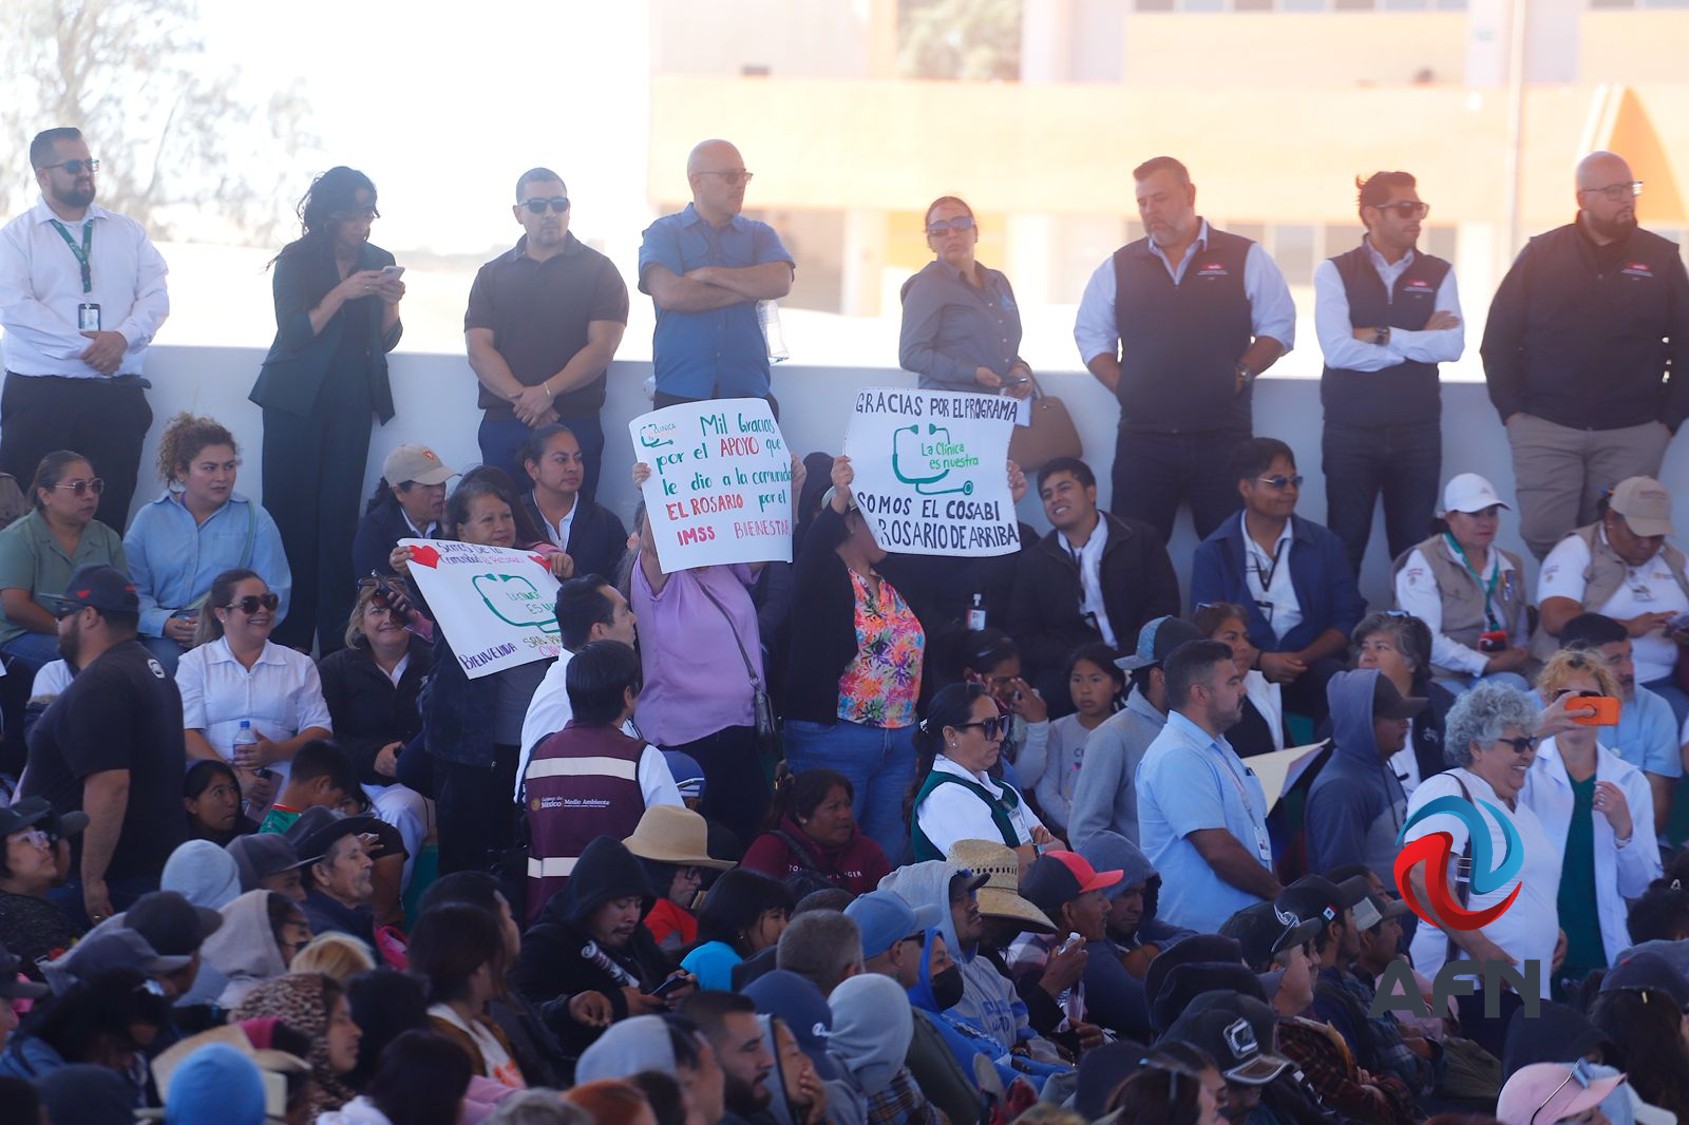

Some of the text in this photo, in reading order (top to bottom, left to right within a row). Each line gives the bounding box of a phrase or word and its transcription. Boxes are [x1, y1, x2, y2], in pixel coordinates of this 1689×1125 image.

[855, 392, 1018, 422] GRACIAS POR EL PROGRAMA
[700, 413, 728, 437] Mil
[738, 413, 775, 433] Gracias
[656, 436, 781, 475] por el APOYO que
[921, 443, 933, 456] La
[930, 453, 979, 470] es nuestra
[662, 479, 678, 496] le
[691, 472, 713, 491] dio
[722, 476, 731, 486] a
[735, 467, 748, 485] la
[666, 489, 787, 521] EL ROSARIO por el
[857, 492, 1000, 521] SOMOS EL COSABI
[677, 526, 716, 546] IMSS
[950, 525, 966, 549] DE
[968, 523, 1019, 549] ARRIBA
